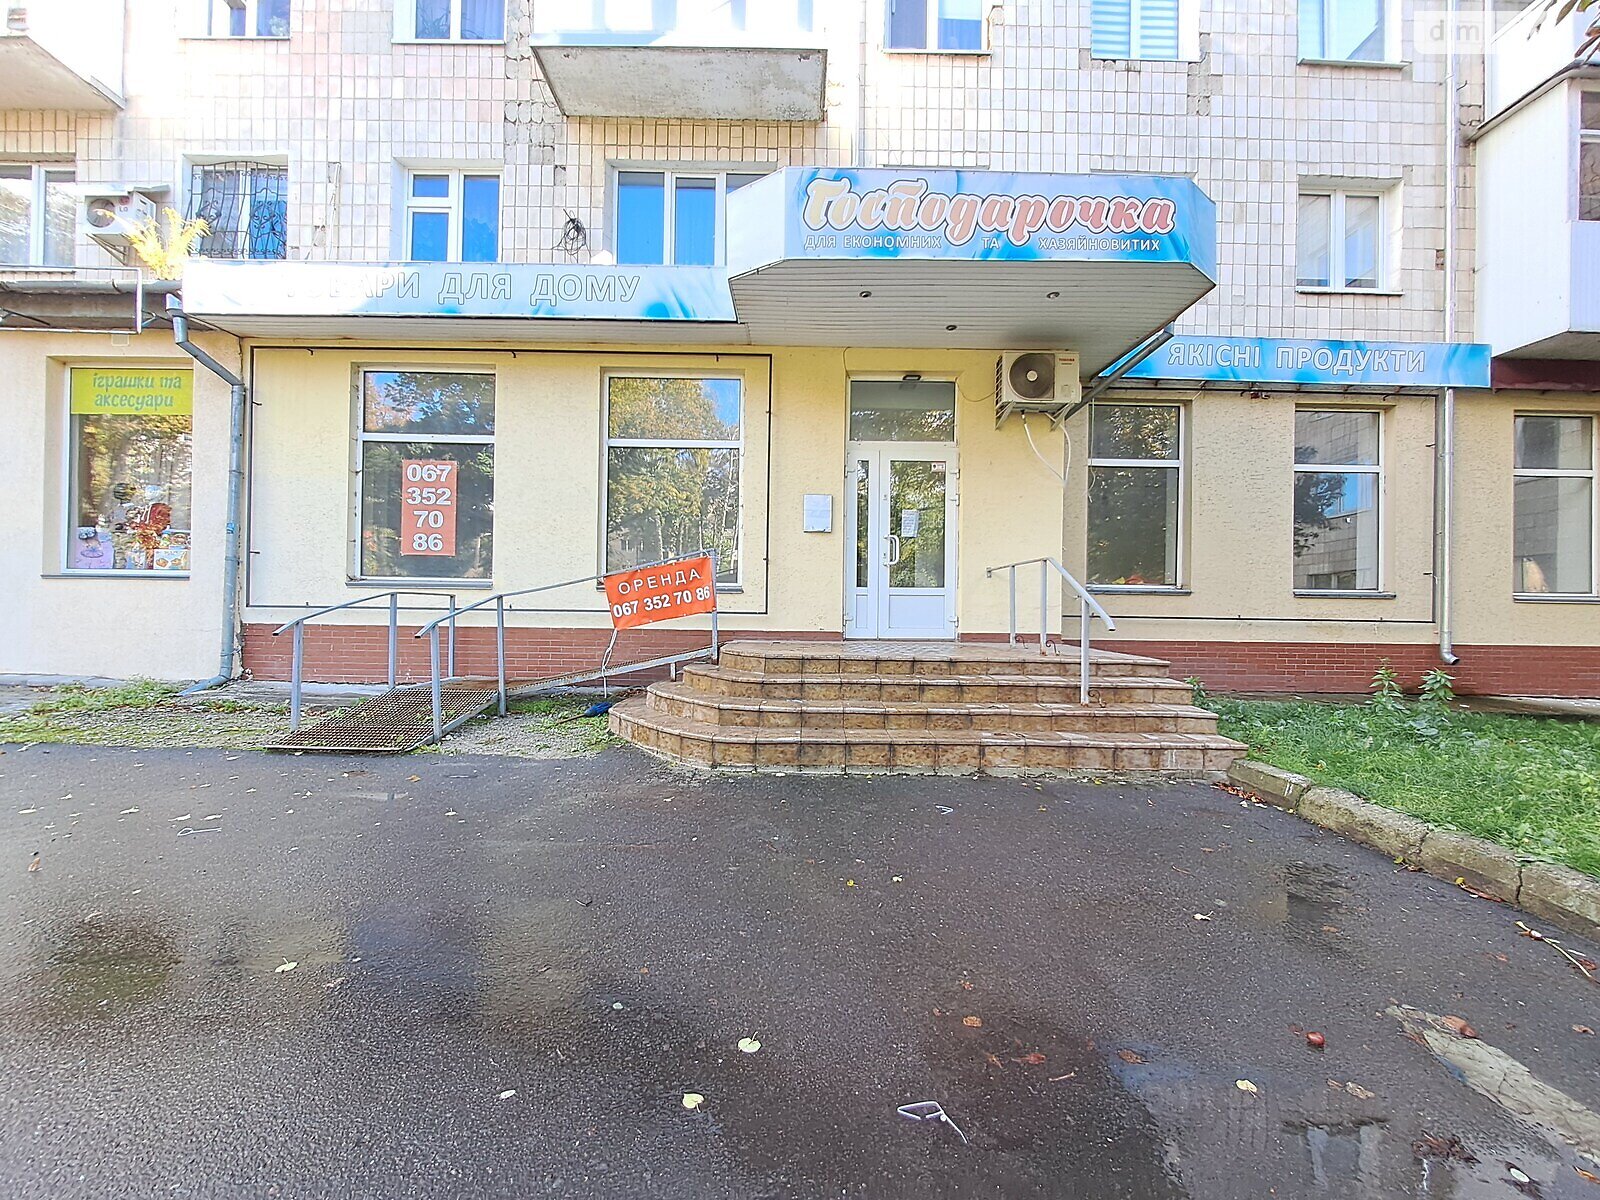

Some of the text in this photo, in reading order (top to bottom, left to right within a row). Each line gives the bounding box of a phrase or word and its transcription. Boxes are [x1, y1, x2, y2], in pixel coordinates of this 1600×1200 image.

[803, 177, 1176, 246] Господарочка
[804, 235, 1160, 251] ДЛЯ ЕКОНОМНИХ ТА ХАЗЯЙНОВИТИХ
[437, 272, 512, 305] ДЛЯ
[529, 273, 640, 307] ДОМУ
[1168, 343, 1425, 376] ЯКІСНІ ПРОДУКТИ
[93, 372, 182, 392] іграшки та
[94, 393, 173, 411] аксесуари
[406, 464, 452, 482] 067
[406, 487, 452, 506] 352
[413, 510, 444, 528] 70
[412, 533, 443, 551] 86
[618, 568, 700, 595] ОРЕНДА
[613, 585, 711, 618] 067 352 70 86
